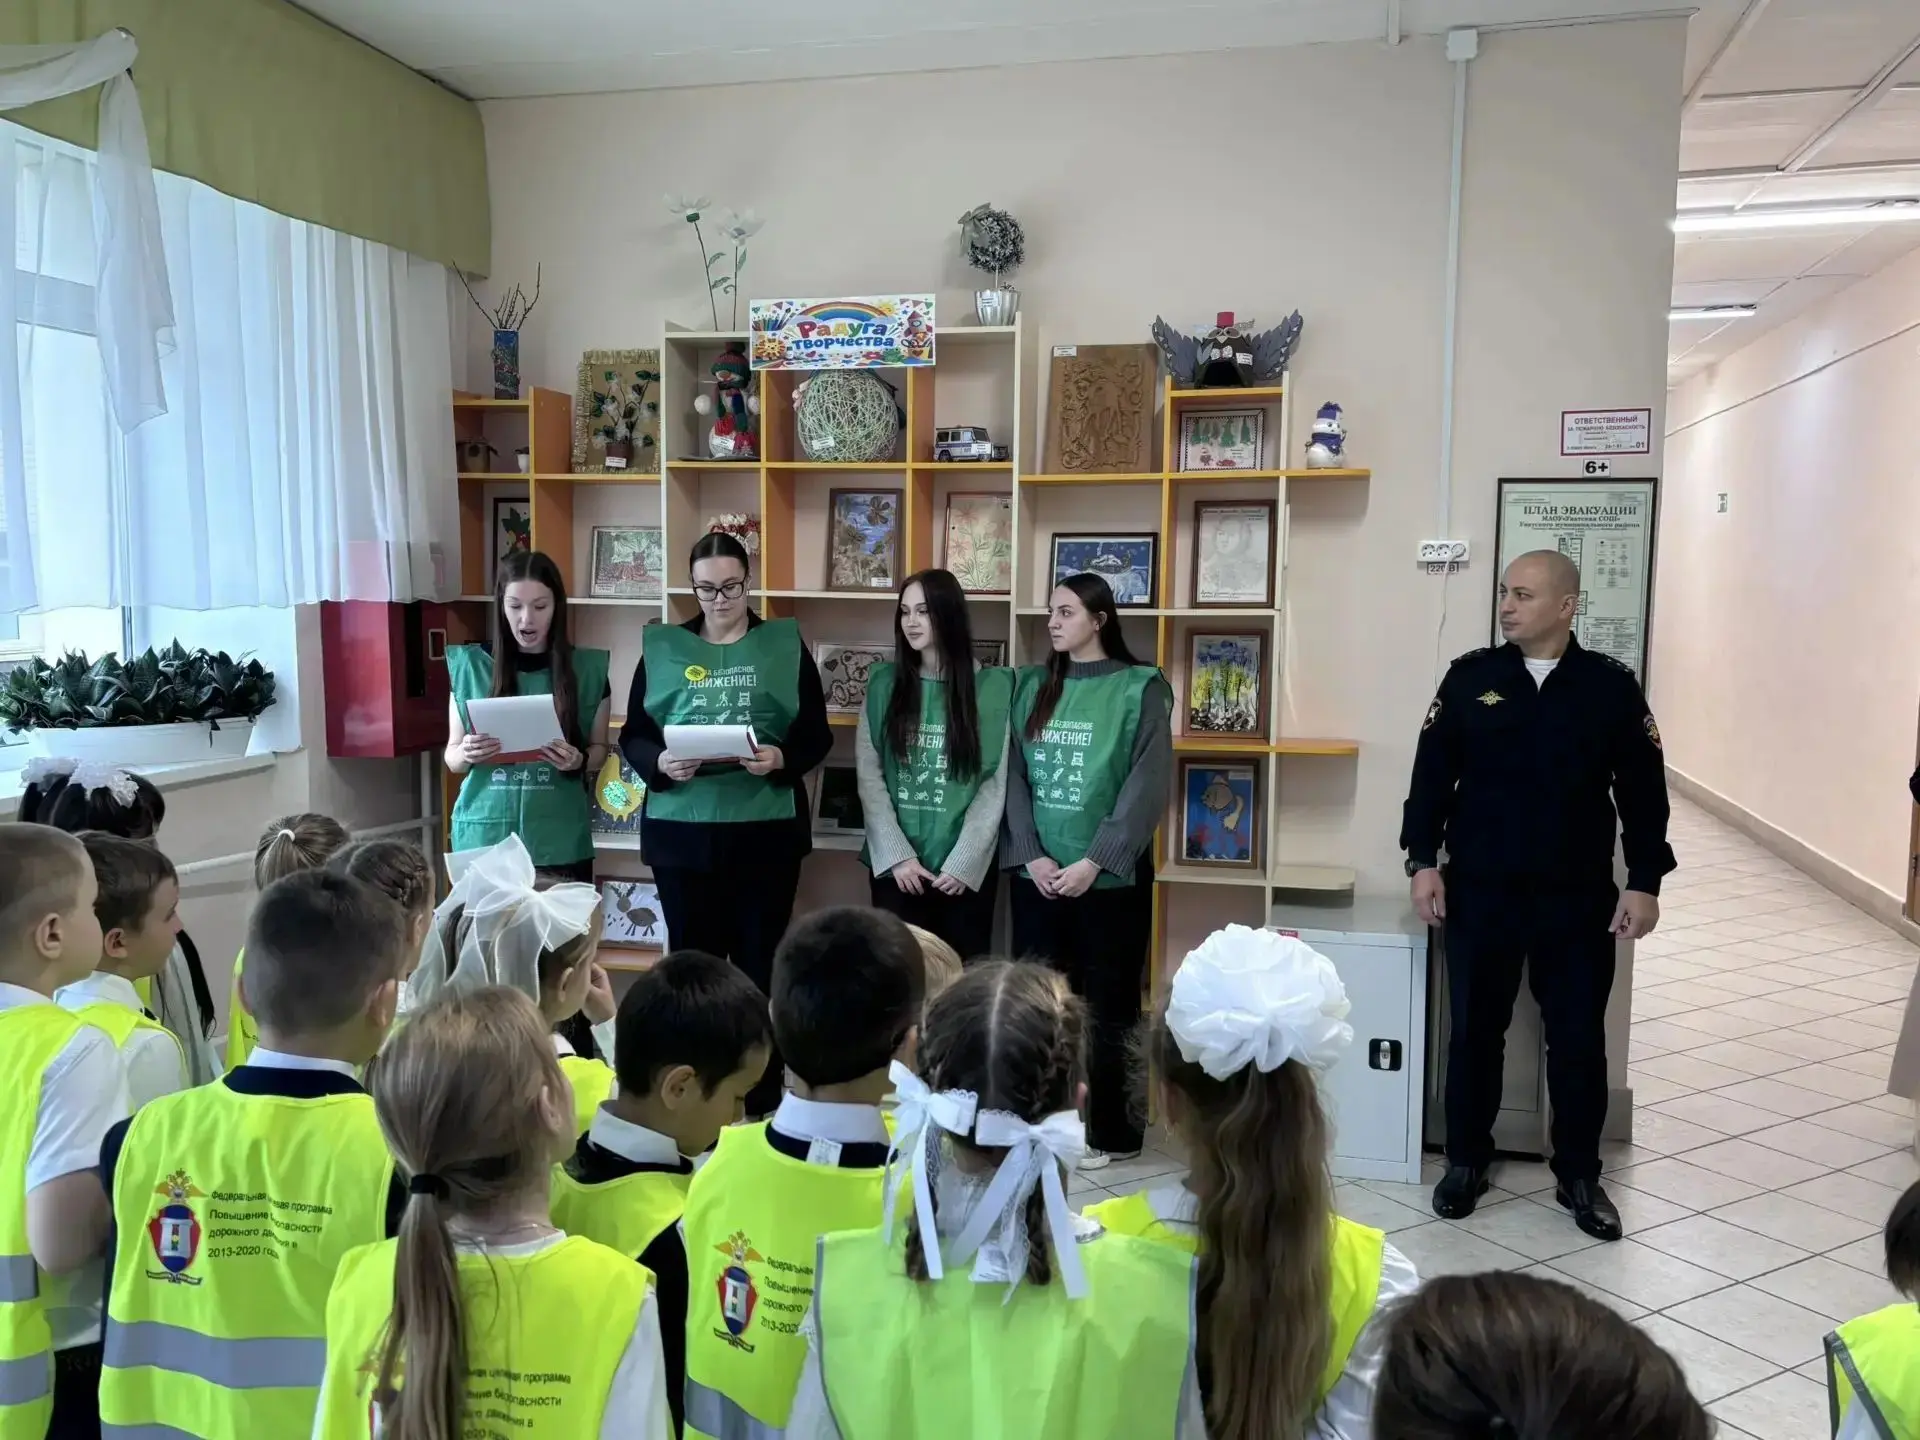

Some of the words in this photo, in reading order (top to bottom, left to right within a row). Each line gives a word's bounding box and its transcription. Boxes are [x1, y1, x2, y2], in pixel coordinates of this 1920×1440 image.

[797, 321, 888, 338] Радуга
[1574, 415, 1638, 425] ОТВЕТСТВЕННЫЙ
[1585, 461, 1608, 474] 6+
[1523, 506, 1558, 515] ПЛАН
[1560, 506, 1637, 516] ЭВАКУАЦИИ
[713, 665, 755, 677] БЕЗОПАСНОЕ
[211, 1190, 267, 1203] Федеральная
[291, 1202, 333, 1215] программа
[209, 1209, 269, 1220] Повышение
[208, 1228, 260, 1240] дорожного
[208, 1246, 261, 1258] 2013-2020
[523, 1373, 571, 1384] программа
